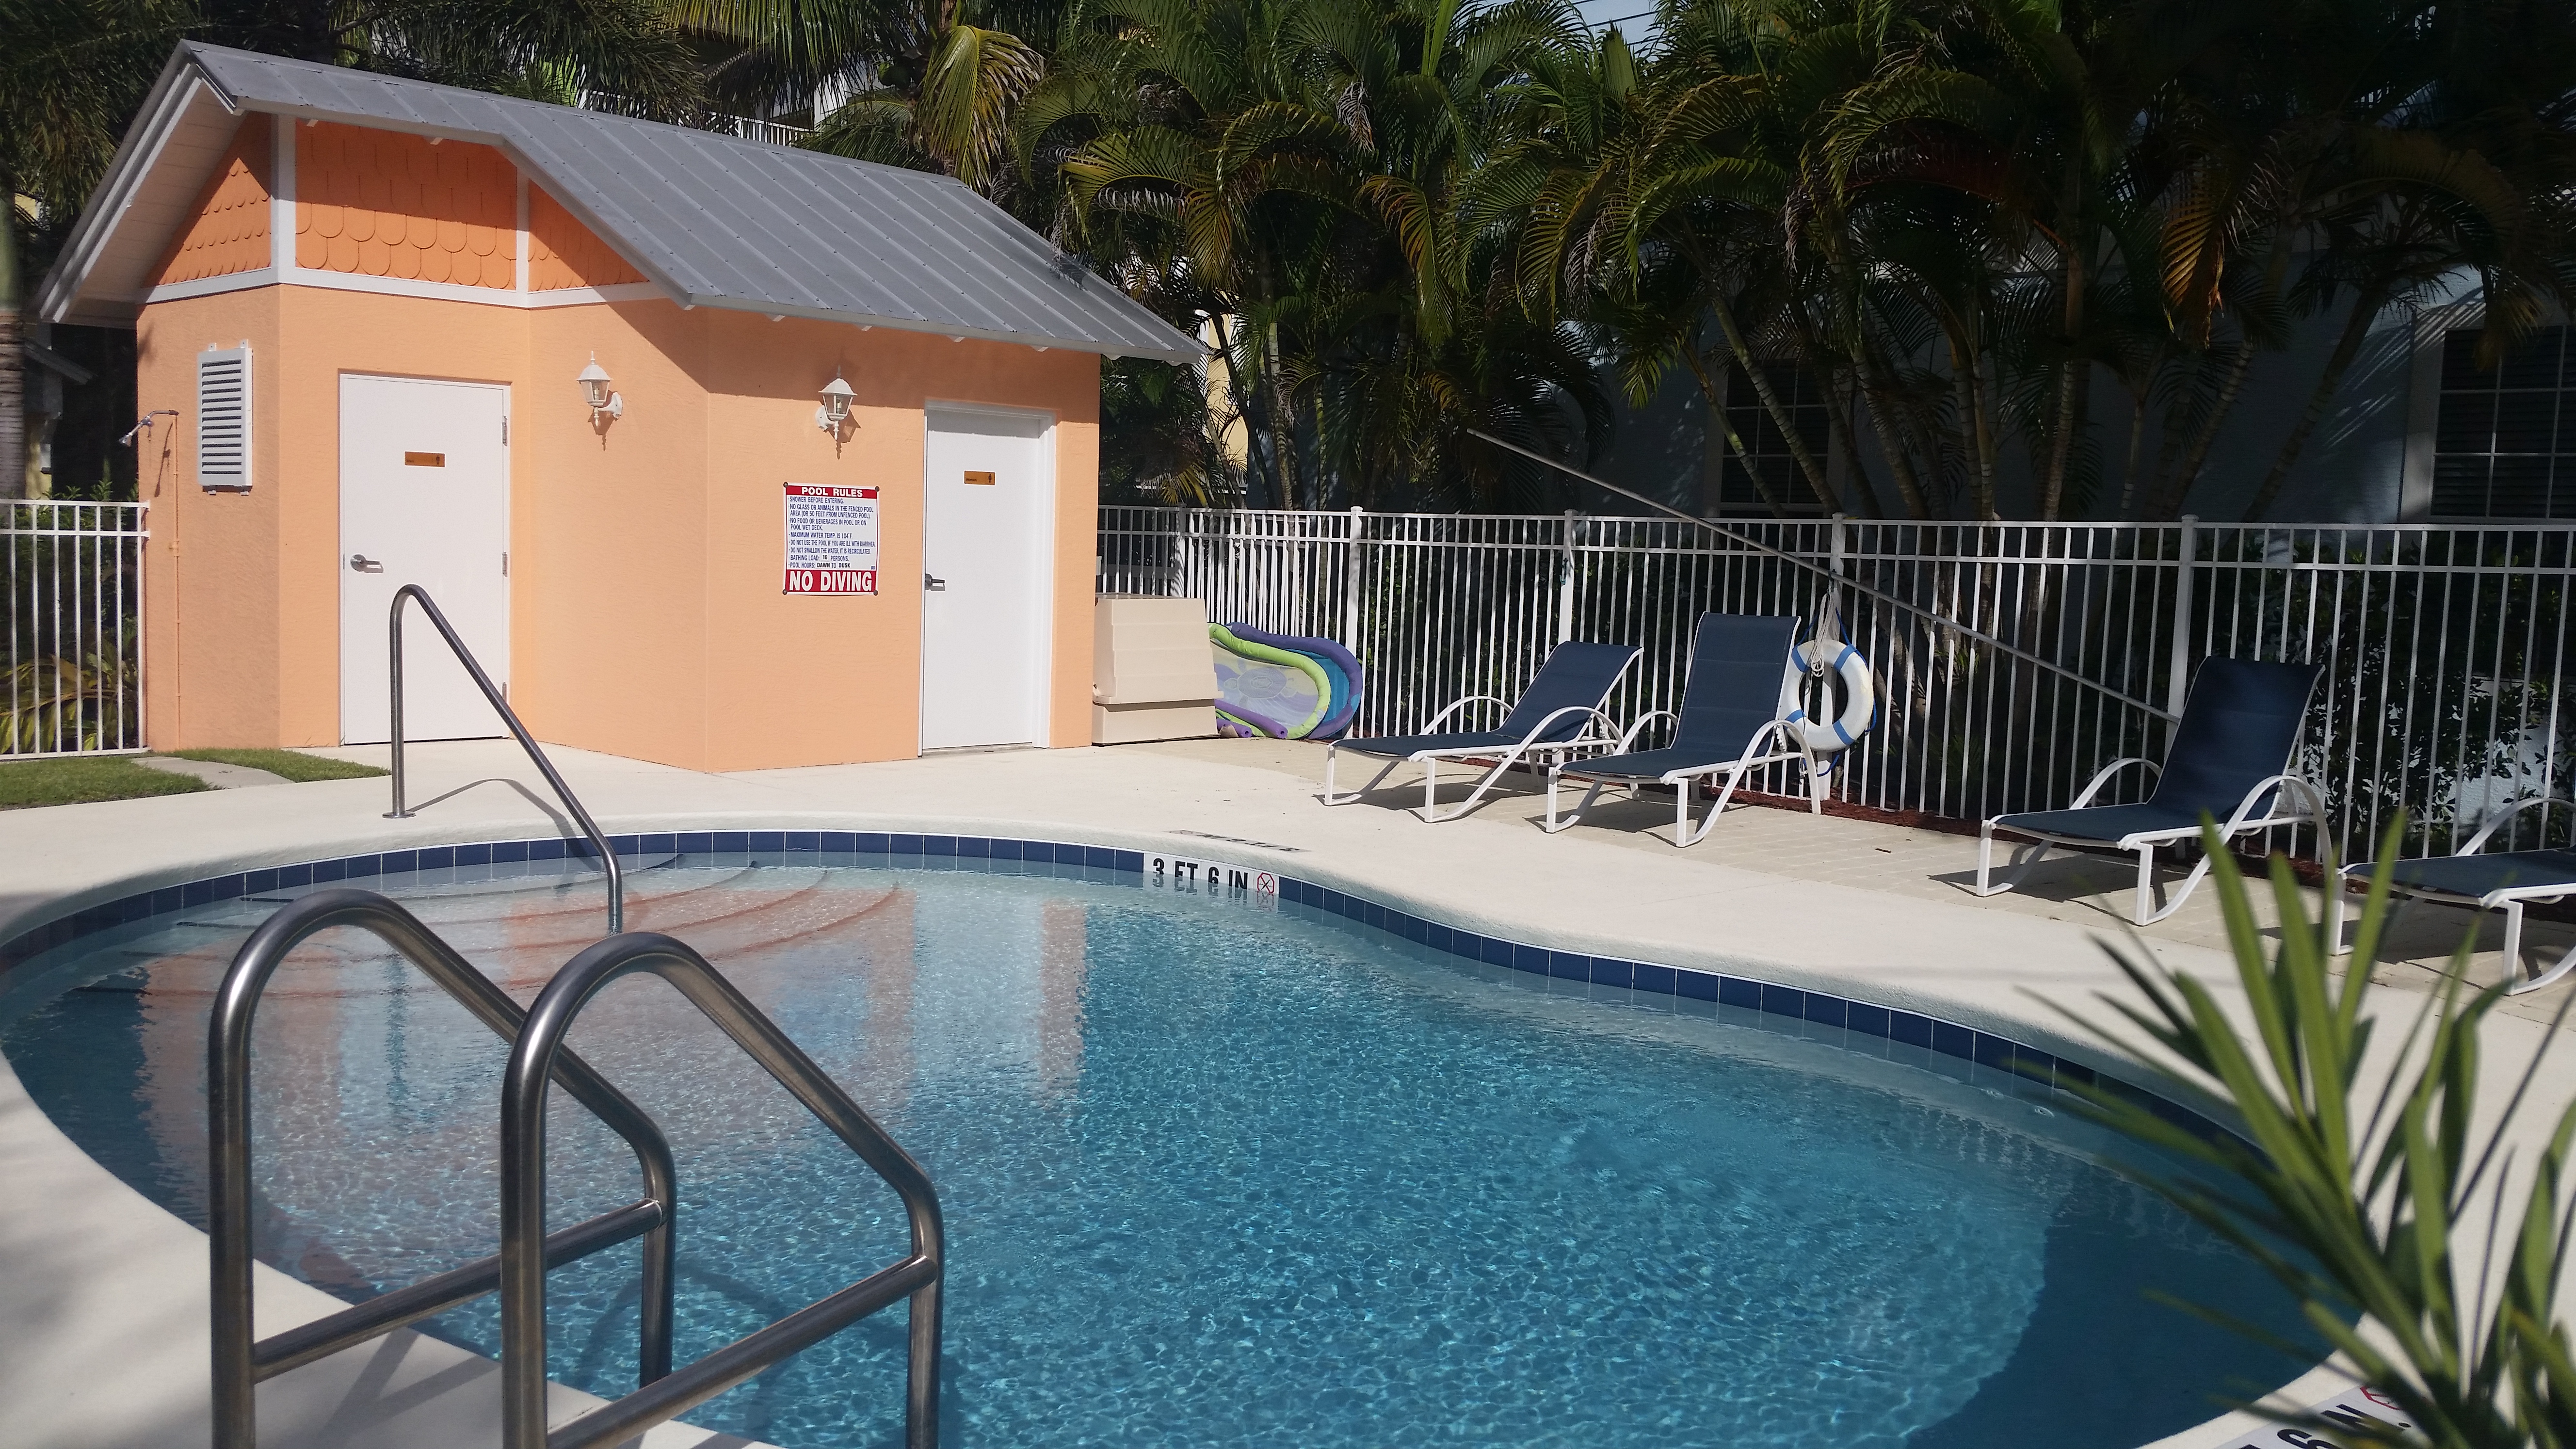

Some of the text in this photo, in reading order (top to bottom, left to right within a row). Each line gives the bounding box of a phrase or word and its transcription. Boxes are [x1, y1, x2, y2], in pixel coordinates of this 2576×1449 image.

[802, 487, 863, 497] POOL RULES
[789, 571, 872, 591] NO DIVING
[1153, 858, 1248, 890] 3 FT 6 IN
